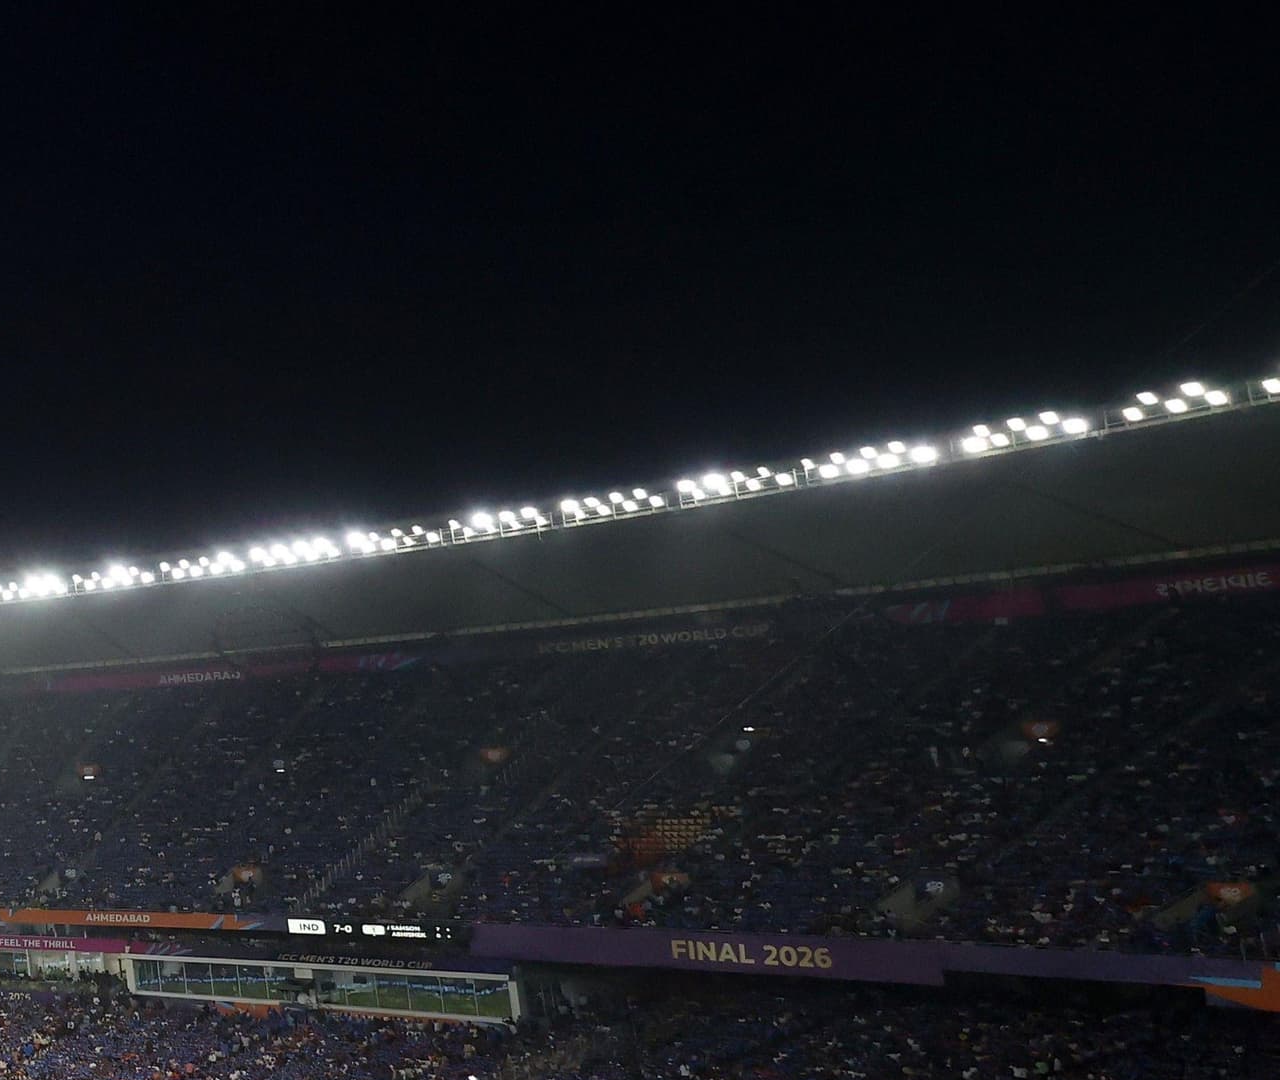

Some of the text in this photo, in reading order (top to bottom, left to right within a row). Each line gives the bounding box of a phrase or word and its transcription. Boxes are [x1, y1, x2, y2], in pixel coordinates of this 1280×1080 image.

[661, 627, 727, 646] WORLD
[730, 624, 769, 639] CUP
[85, 913, 151, 923] AHMEDABAD
[299, 923, 320, 932] IND
[23, 939, 41, 948] THE
[42, 940, 77, 949] THRILL
[671, 939, 833, 968] FINAL 2026
